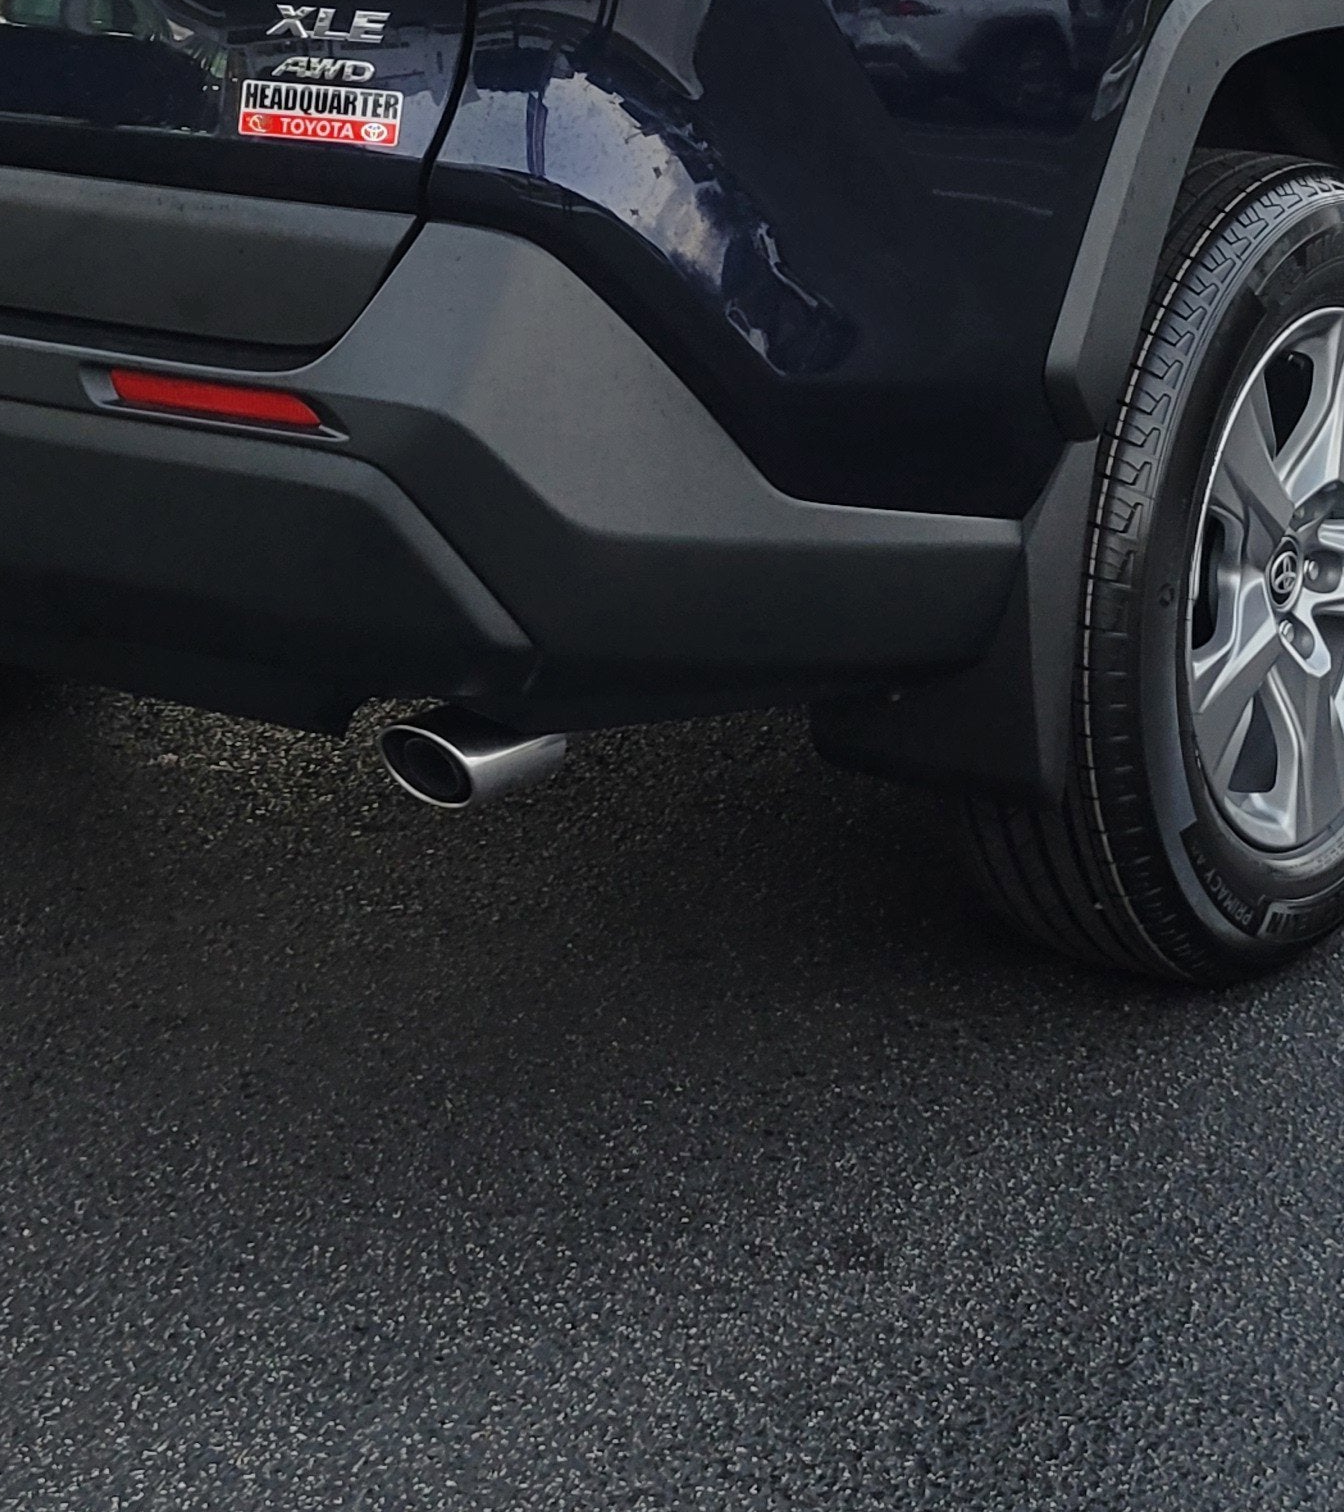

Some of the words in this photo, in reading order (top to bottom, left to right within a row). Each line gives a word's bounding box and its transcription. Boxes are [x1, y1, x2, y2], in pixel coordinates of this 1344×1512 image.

[266, 4, 391, 43] XLE
[271, 56, 375, 82] AWD
[244, 83, 399, 120] HEADQUARTER
[280, 117, 354, 139] TOYOTA
